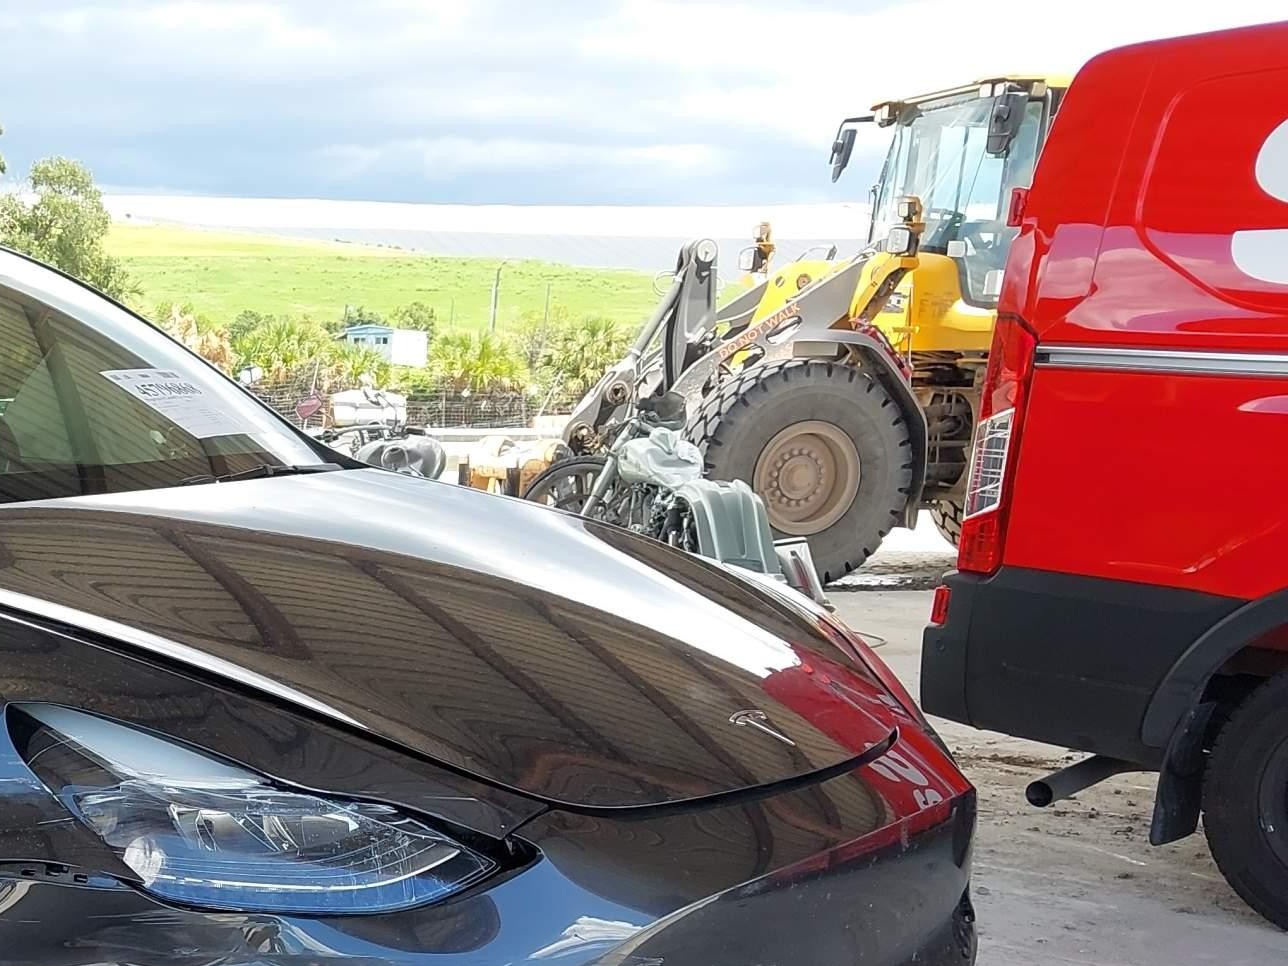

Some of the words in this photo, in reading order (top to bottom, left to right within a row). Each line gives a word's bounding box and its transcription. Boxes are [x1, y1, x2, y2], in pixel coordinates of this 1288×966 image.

[719, 342, 737, 358] DO
[737, 326, 765, 347] NOT
[766, 303, 800, 327] WALK
